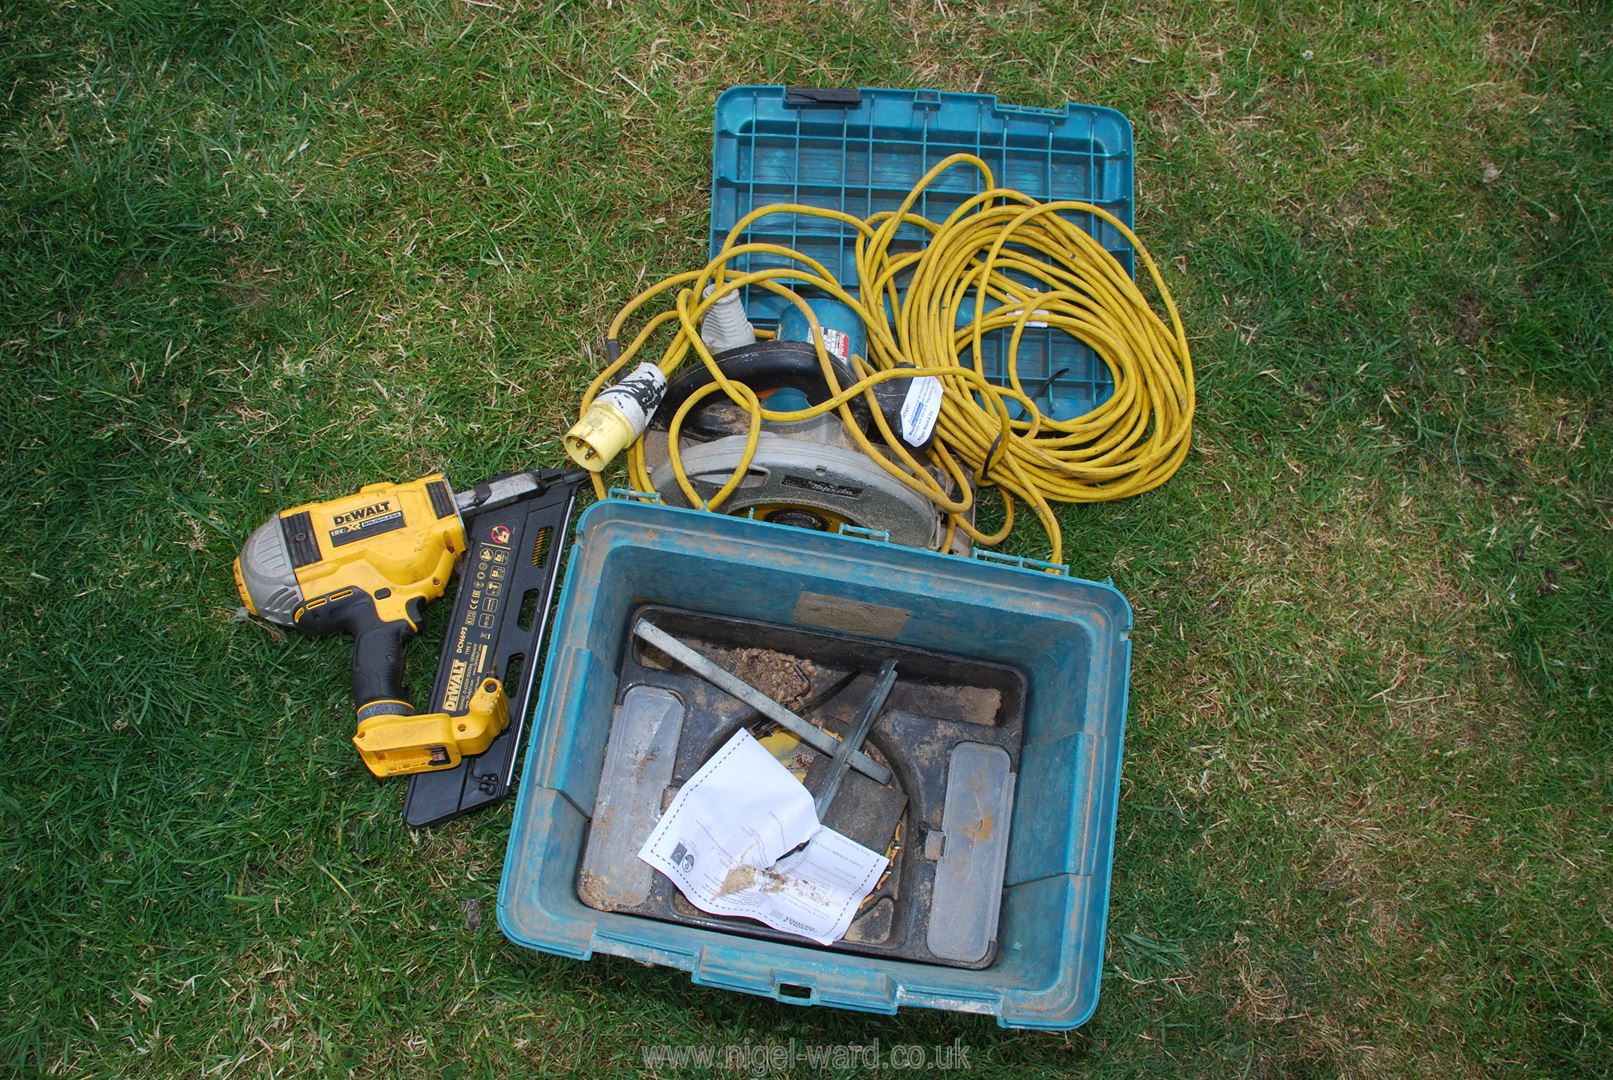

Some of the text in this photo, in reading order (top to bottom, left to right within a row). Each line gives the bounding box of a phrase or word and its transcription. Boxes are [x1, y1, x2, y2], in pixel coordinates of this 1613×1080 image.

[333, 501, 390, 526] DEWALT
[345, 520, 361, 533] XR
[456, 626, 468, 654] DCN692
[443, 659, 467, 711] DEWALT
